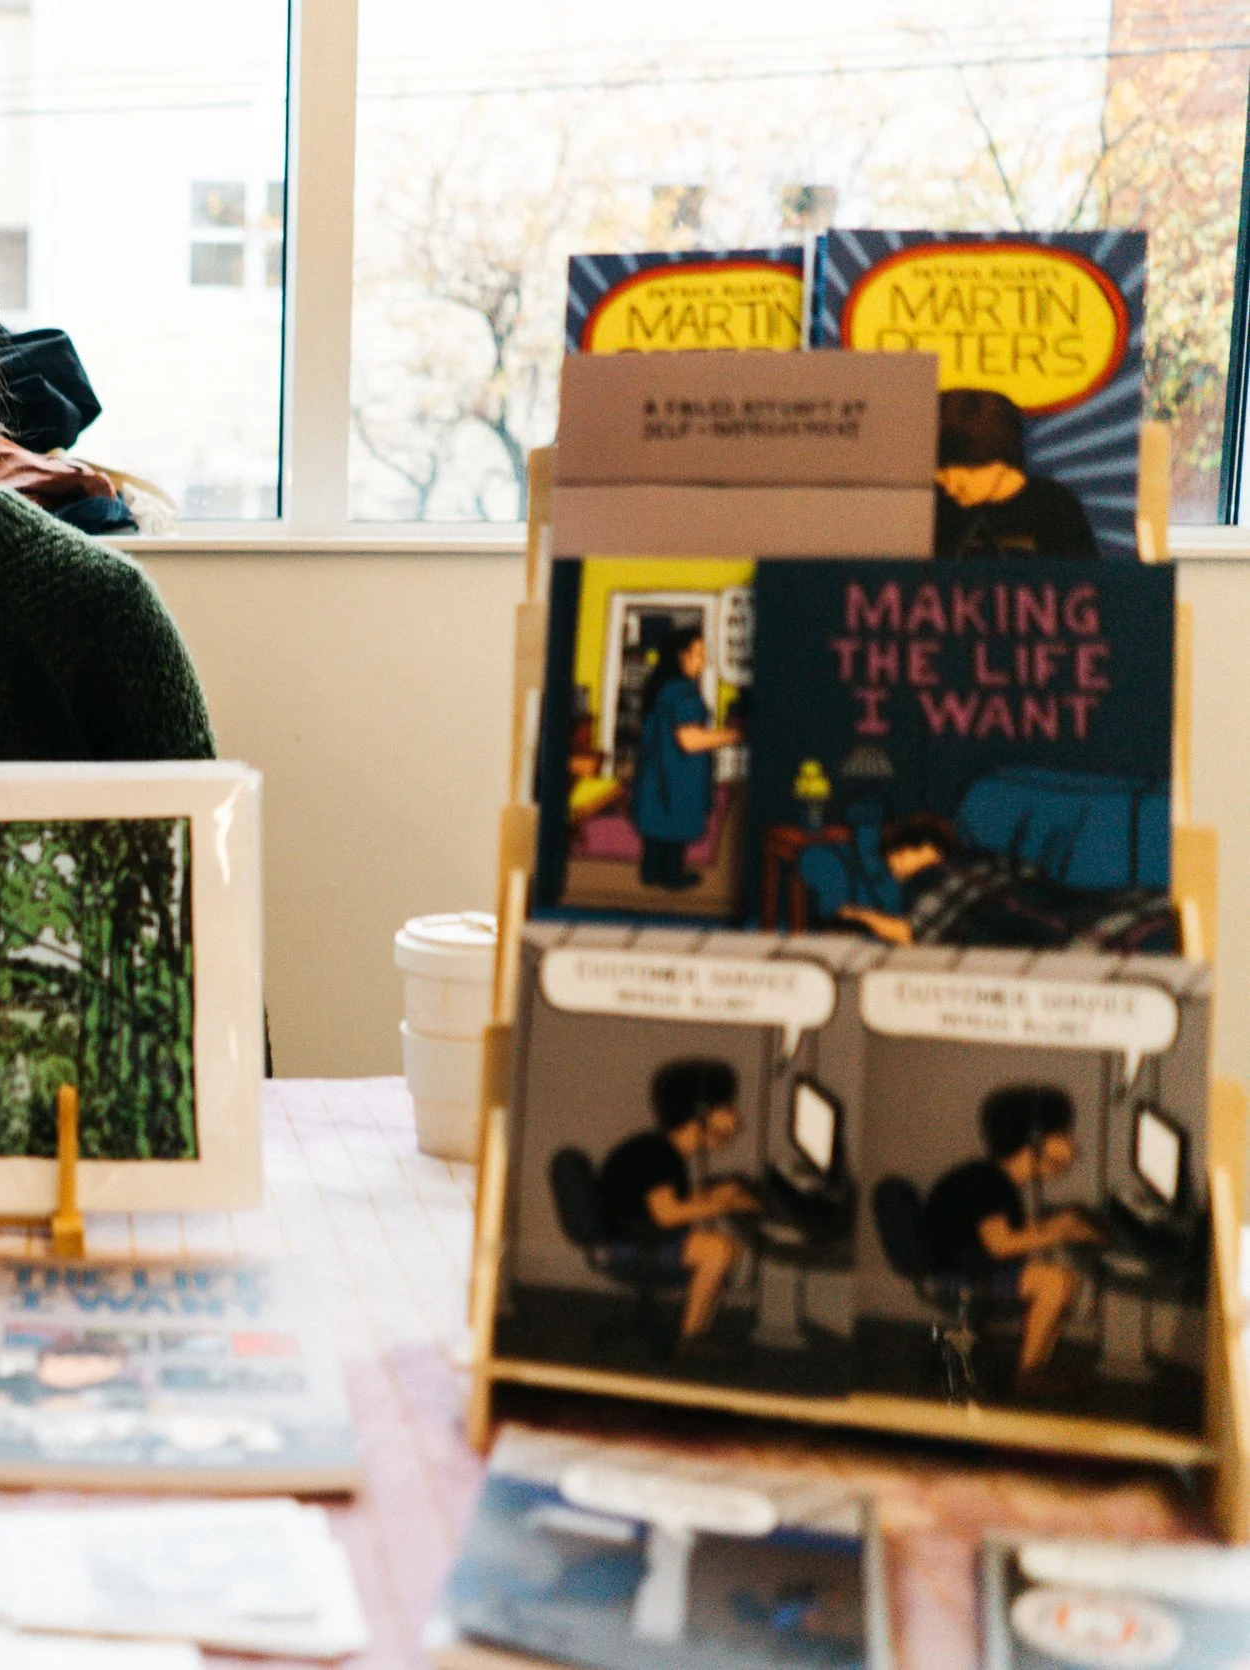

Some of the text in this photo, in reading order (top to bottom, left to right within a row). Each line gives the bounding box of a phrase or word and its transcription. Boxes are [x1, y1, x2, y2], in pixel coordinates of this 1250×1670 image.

[626, 302, 802, 345] MARTIN
[889, 282, 1080, 328] MARTIN
[844, 580, 1100, 636] MAKING
[830, 638, 1112, 691] THE LIFE
[852, 687, 1099, 740] I WANT
[576, 959, 696, 986] CUSTOMER
[892, 979, 1024, 1009] CUSTOMER
